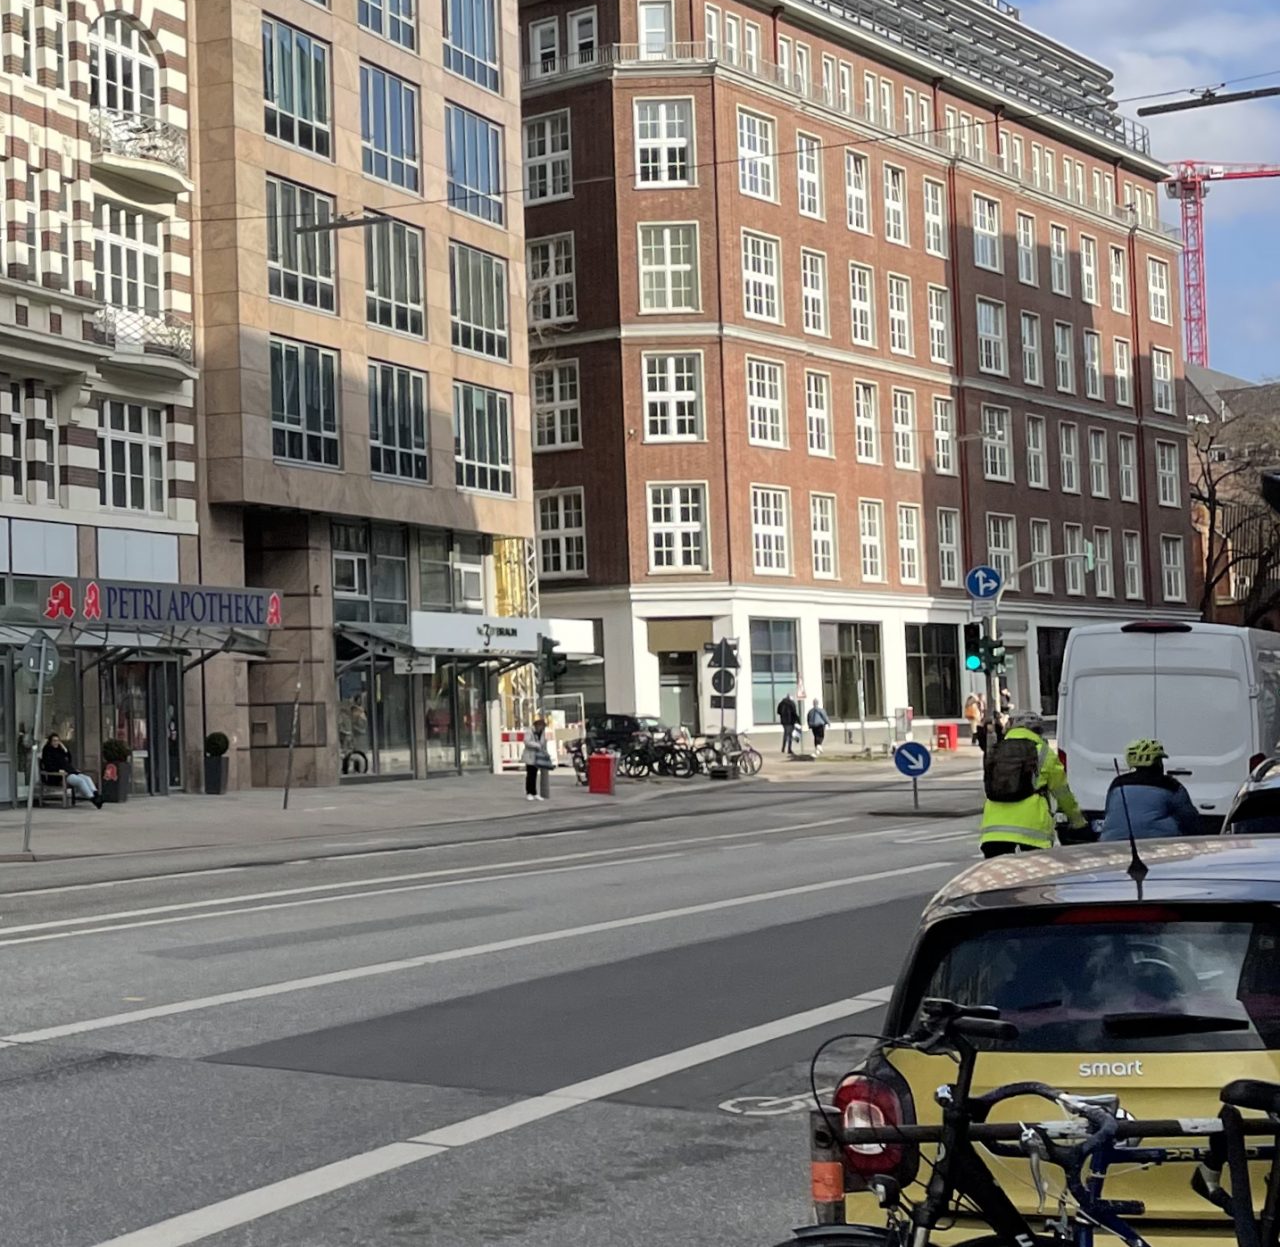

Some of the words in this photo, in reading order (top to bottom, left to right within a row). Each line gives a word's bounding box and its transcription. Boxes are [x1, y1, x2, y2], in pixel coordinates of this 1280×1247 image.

[106, 586, 163, 620] PETRI
[167, 591, 264, 625] APOTHEKE
[1079, 1060, 1144, 1076] smart
